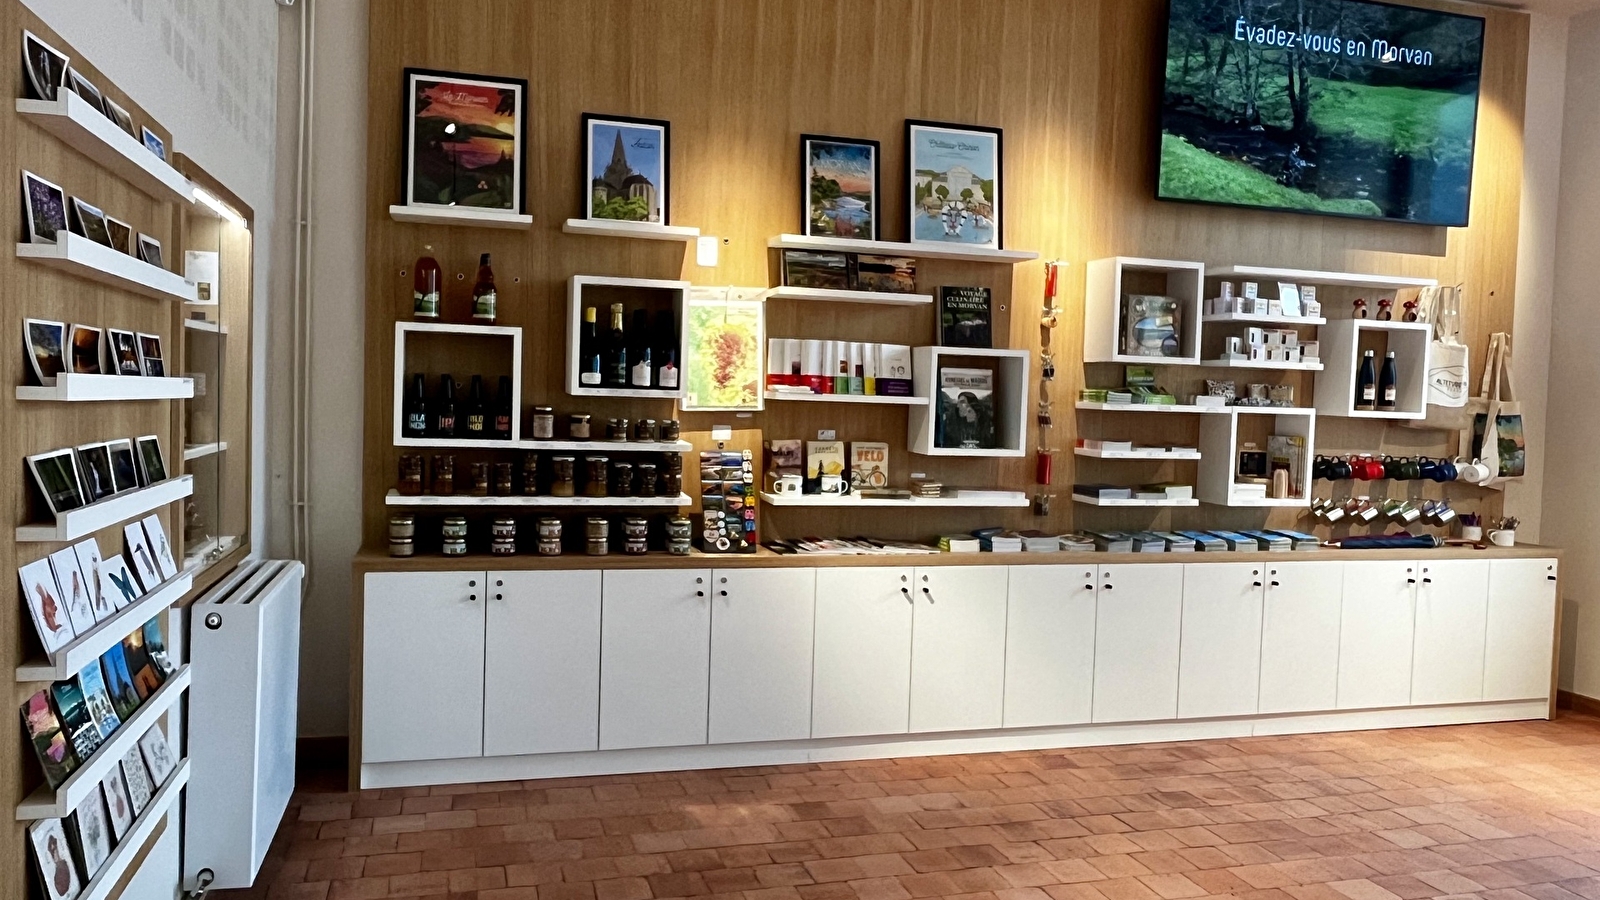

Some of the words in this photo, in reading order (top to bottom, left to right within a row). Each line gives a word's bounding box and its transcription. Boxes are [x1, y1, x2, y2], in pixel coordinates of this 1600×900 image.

[1234, 15, 1341, 53] Évadez-vous
[1346, 39, 1365, 57] en
[1371, 39, 1432, 66] Morvan
[958, 302, 988, 310] MORVAN
